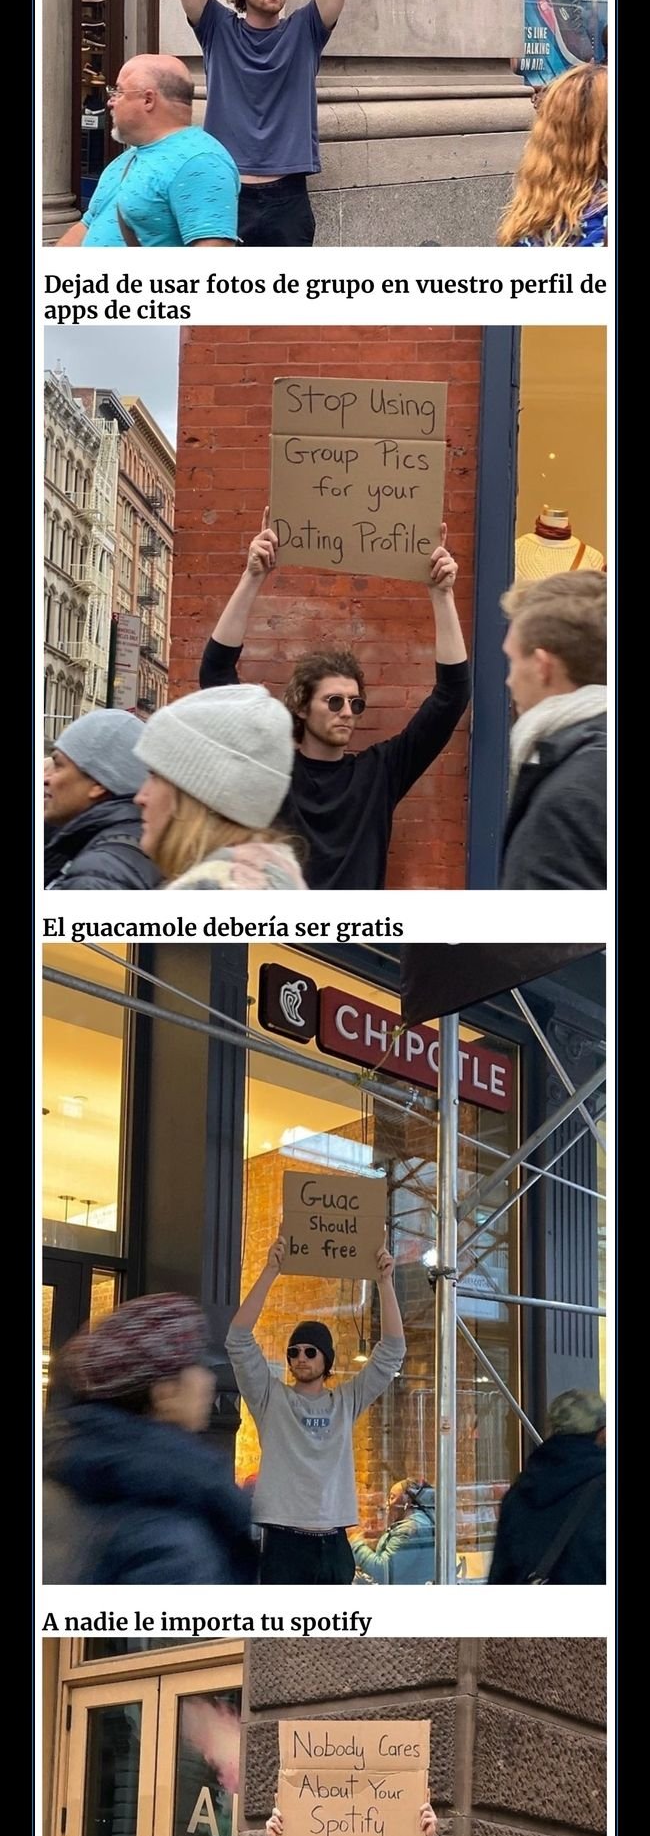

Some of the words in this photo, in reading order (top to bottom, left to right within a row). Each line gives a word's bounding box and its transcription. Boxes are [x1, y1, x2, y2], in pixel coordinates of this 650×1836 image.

[286, 384, 357, 429] Stop
[370, 388, 436, 435] Using
[284, 437, 359, 474] Group
[374, 439, 430, 471] Pics
[312, 475, 353, 497] for
[367, 484, 421, 513] your
[273, 518, 344, 565] Dating
[352, 521, 432, 556] Profile
[300, 1180, 360, 1210] Guac
[289, 1235, 310, 1256] be
[321, 1239, 357, 1259] free
[305, 1417, 327, 1427] NHL
[293, 1730, 366, 1771] Nobody
[378, 1734, 421, 1758] Cares
[299, 1774, 359, 1799] About
[367, 1778, 405, 1800] Your
